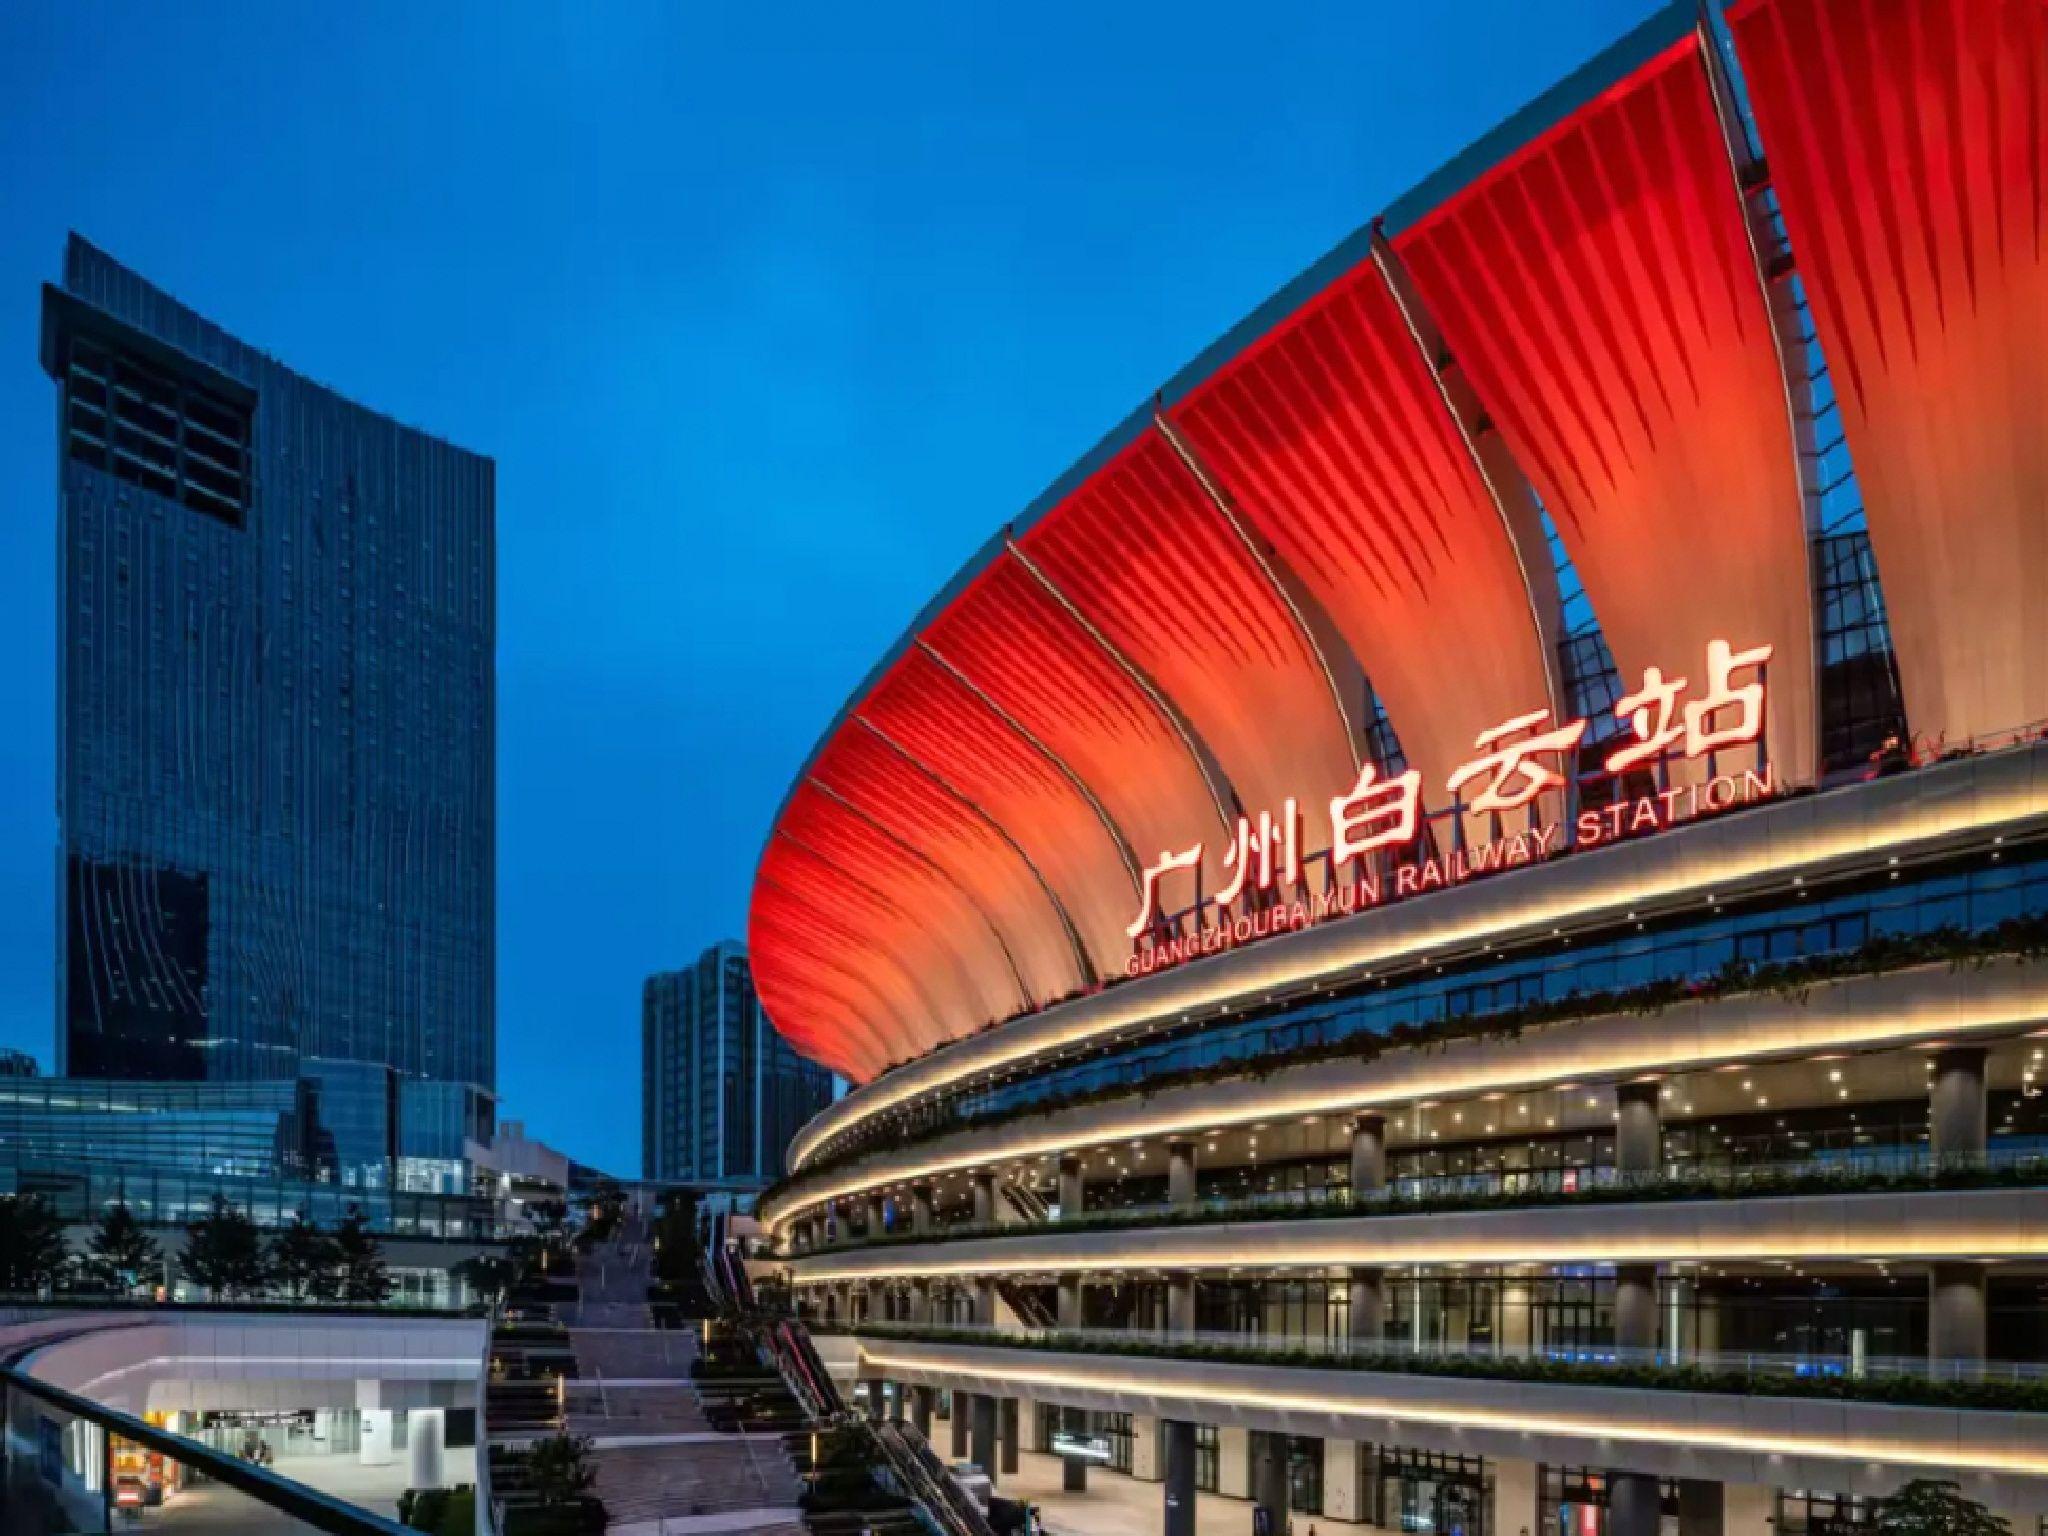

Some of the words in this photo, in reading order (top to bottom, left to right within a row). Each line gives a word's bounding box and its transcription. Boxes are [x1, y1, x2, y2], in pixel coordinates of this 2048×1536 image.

[1126, 639, 1773, 937] 广州白云站
[1396, 823, 1557, 896] RAILWAY
[1577, 762, 1773, 845] STATION
